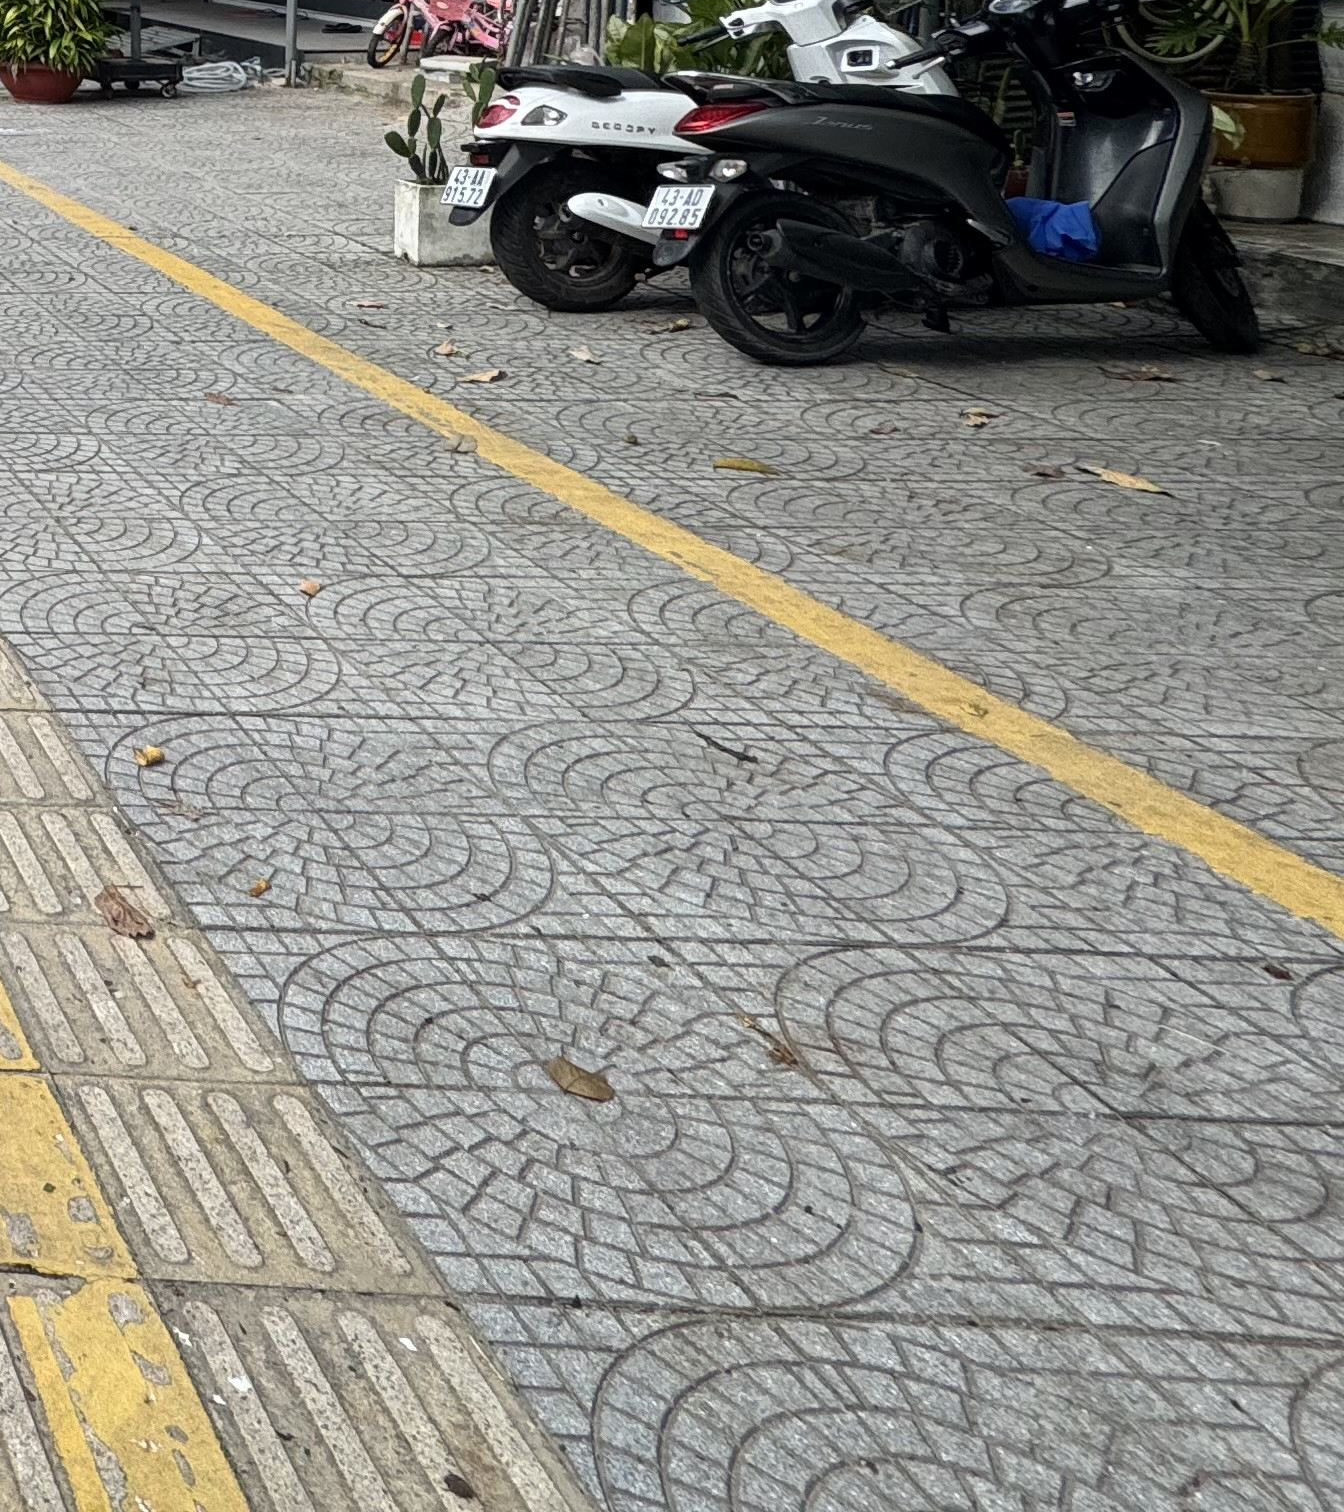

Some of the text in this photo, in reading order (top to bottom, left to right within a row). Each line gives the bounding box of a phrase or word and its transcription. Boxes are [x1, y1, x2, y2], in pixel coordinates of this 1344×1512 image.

[454, 168, 486, 187] 43-AA
[442, 185, 484, 205] 915.72
[647, 207, 703, 226] 092.85
